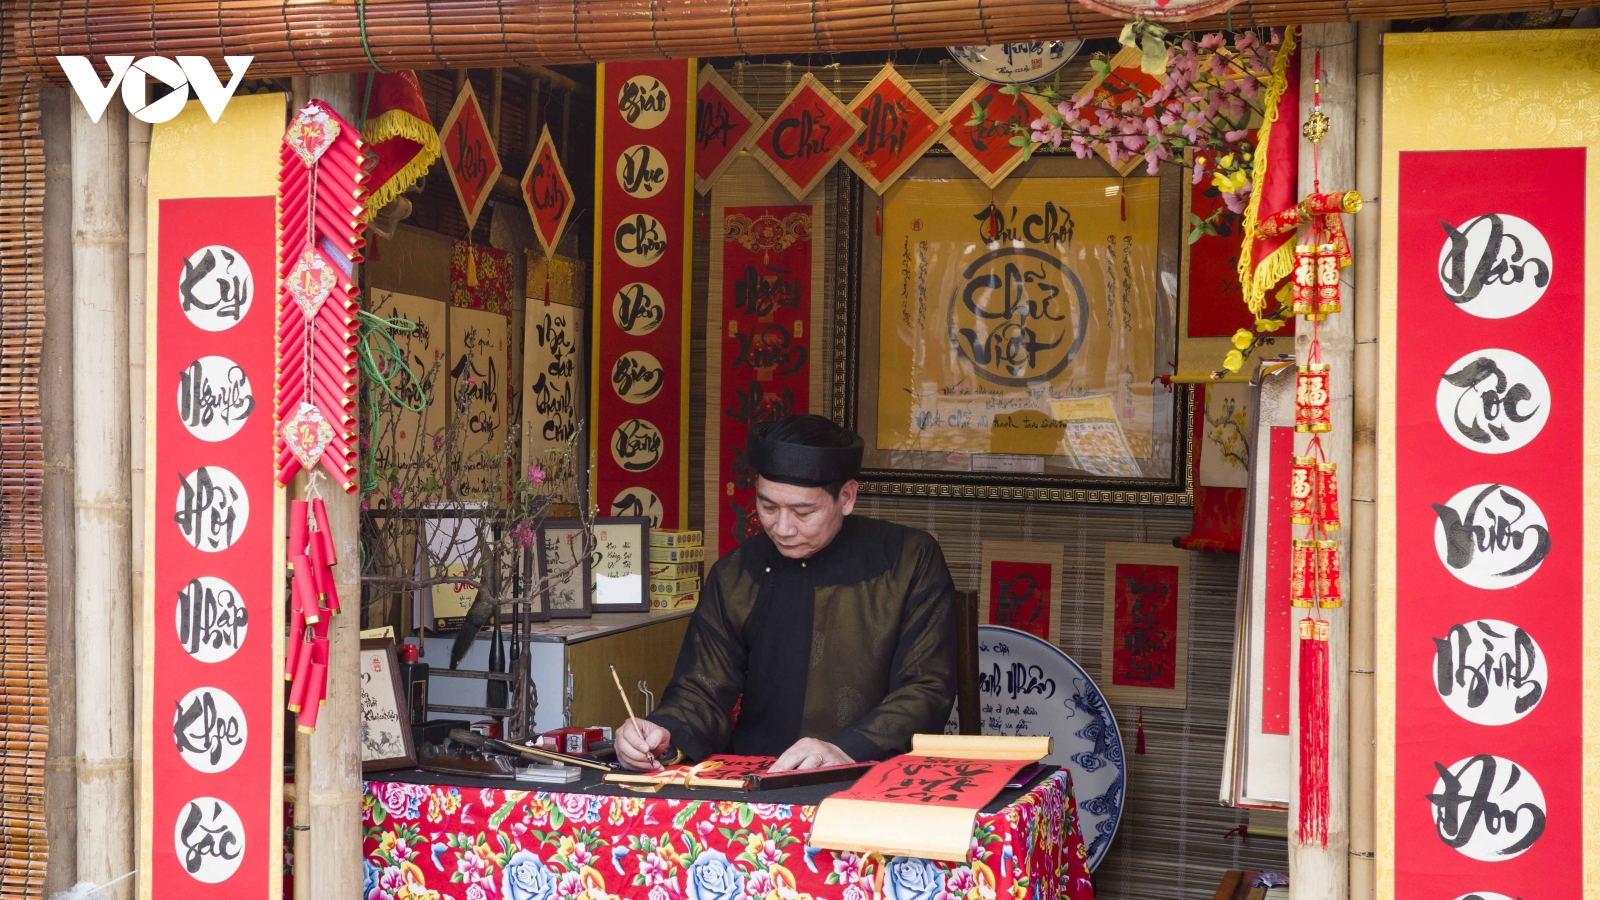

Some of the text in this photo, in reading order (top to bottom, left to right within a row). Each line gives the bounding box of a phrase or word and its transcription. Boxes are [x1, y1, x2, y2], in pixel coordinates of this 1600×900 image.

[618, 80, 667, 123] Giáo
[772, 102, 832, 161] Chữ
[623, 145, 665, 193] Dục
[179, 248, 250, 321] Kỷ
[1440, 213, 1550, 304] Dân
[962, 263, 1065, 326] Chữ
[732, 324, 808, 376] Xuân
[959, 322, 1066, 375] Việt
[179, 359, 255, 427] Nguyên
[532, 372, 573, 418] Thành
[1440, 356, 1542, 444] Tộc
[174, 466, 239, 548] Hội
[176, 578, 249, 654] Nhập
[1006, 663, 1056, 700] Nhân
[181, 801, 244, 873] Sắc
[1425, 754, 1546, 856] Đón
